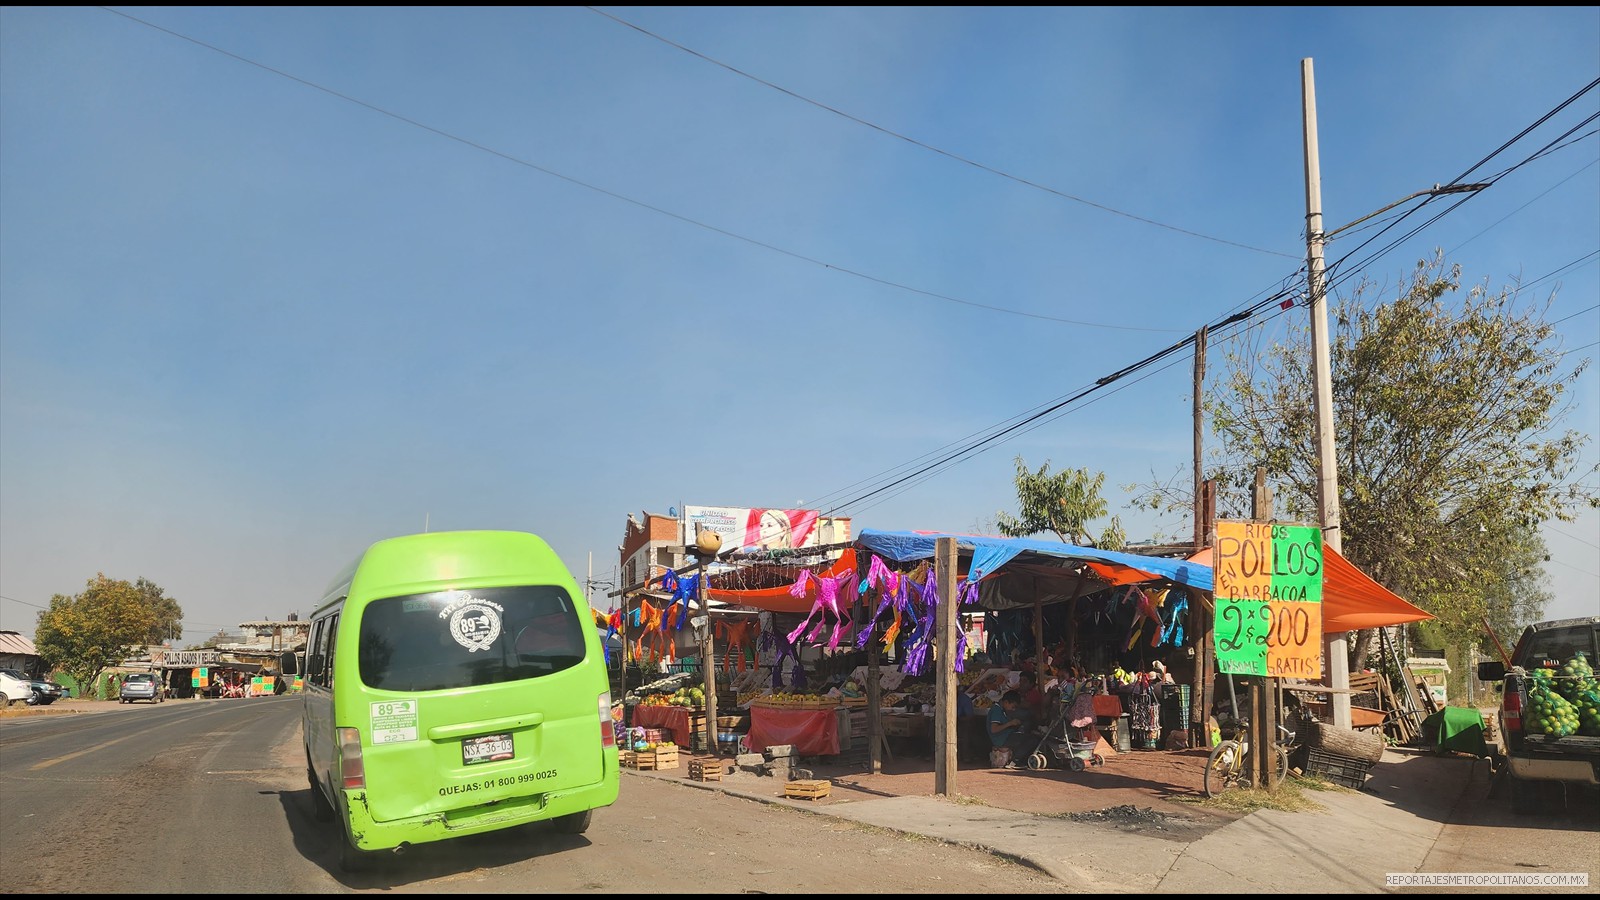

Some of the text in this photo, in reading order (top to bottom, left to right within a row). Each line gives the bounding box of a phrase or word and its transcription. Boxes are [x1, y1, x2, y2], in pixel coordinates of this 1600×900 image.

[1246, 524, 1288, 540] RICOS
[1218, 537, 1320, 578] POLLOS
[1220, 562, 1237, 590] EN
[1229, 585, 1307, 603] BARBACOA
[461, 617, 476, 633] 89
[1219, 605, 1243, 652] 2
[164, 652, 180, 665] POLLOS
[181, 652, 198, 665] ASADOS
[378, 704, 394, 716] 89
[464, 740, 512, 757] NSX-36-03
[439, 769, 558, 796] QUEJAS: 01 800 999 0025
